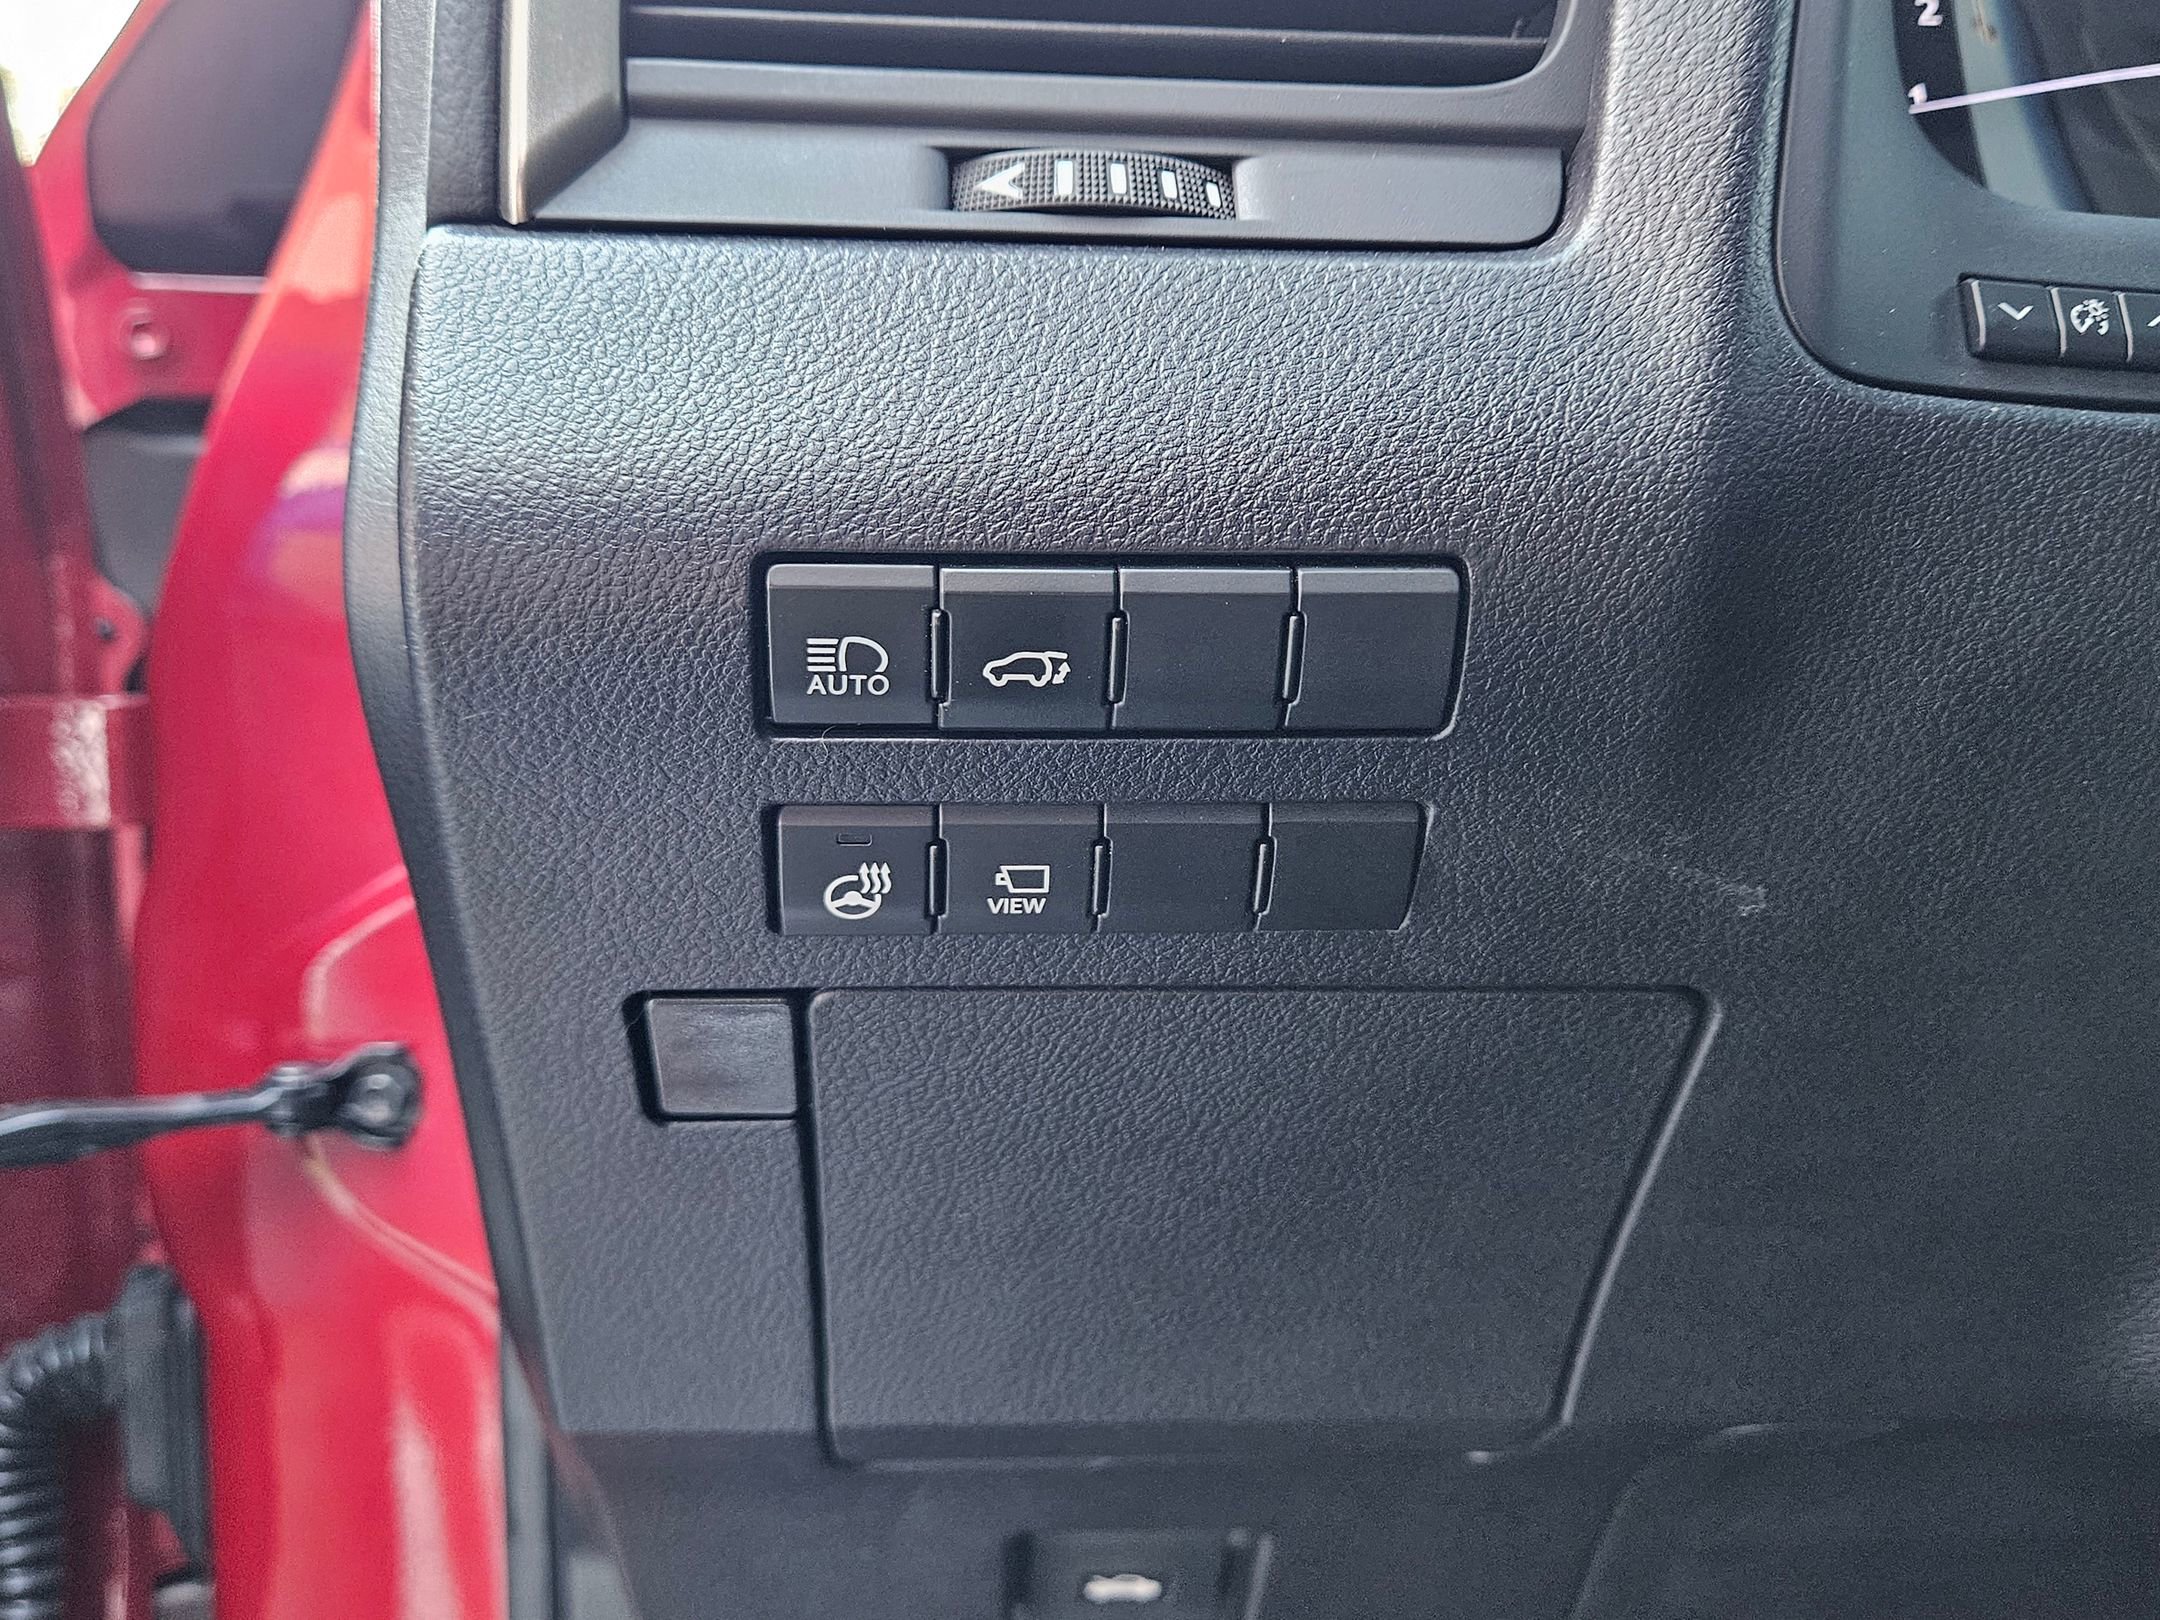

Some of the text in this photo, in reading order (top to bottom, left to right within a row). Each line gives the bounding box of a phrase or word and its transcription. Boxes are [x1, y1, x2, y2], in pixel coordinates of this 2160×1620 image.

[1914, 0, 1943, 27] 2
[1907, 82, 1928, 105] 1
[807, 674, 890, 695] AUTO
[987, 897, 1047, 914] VIEW
